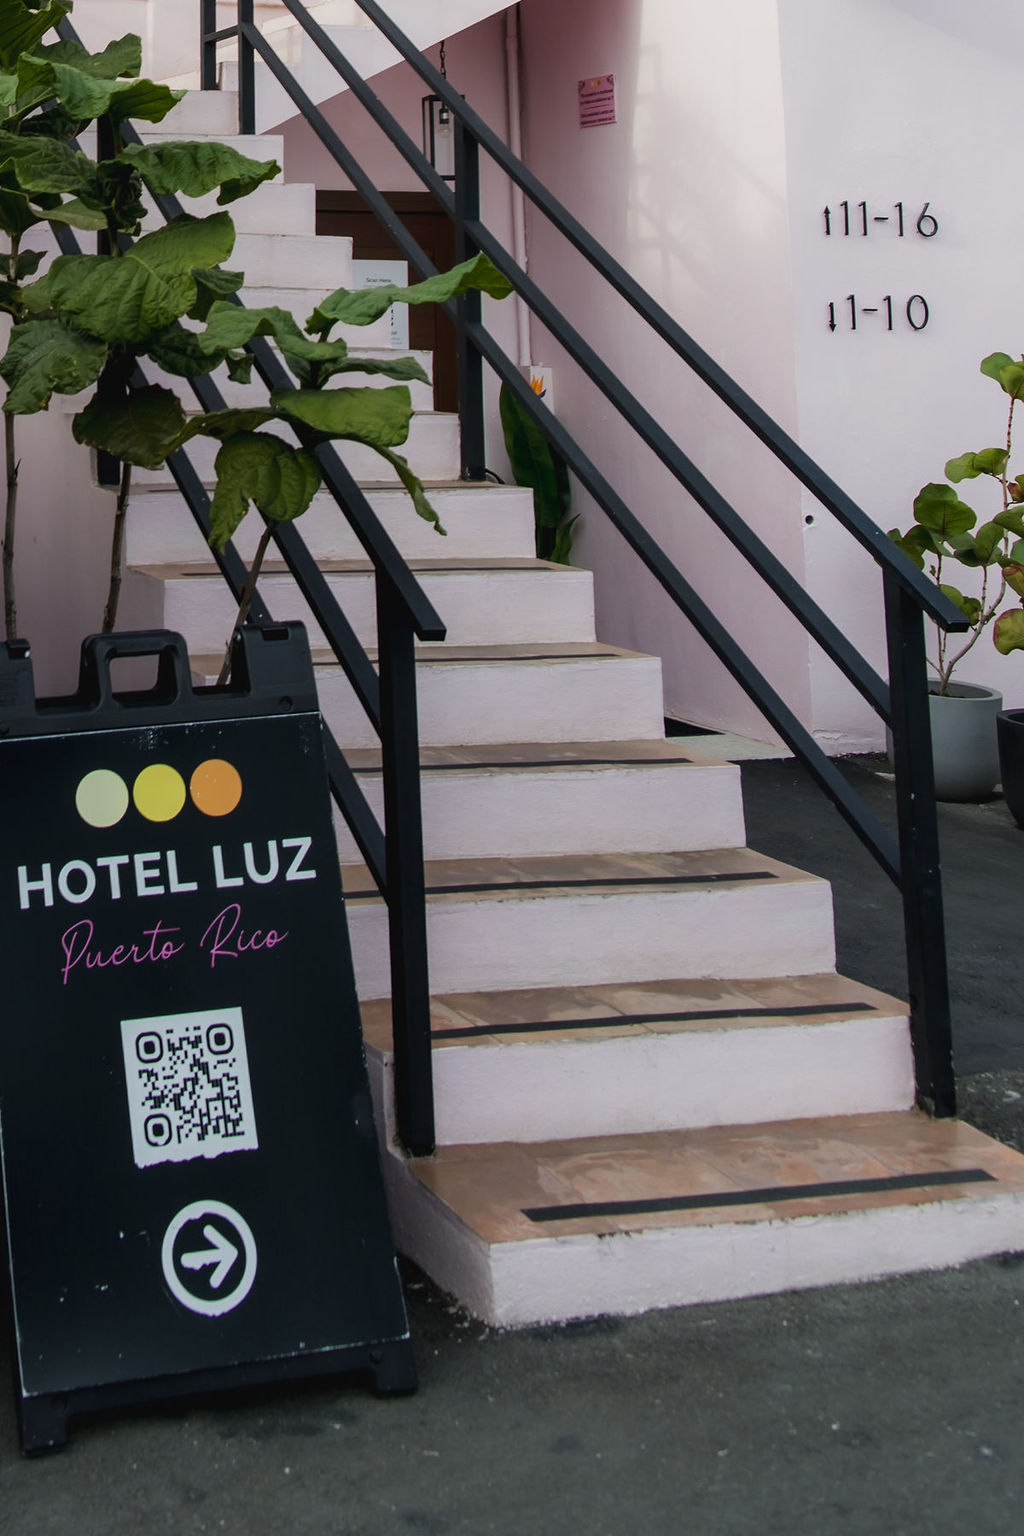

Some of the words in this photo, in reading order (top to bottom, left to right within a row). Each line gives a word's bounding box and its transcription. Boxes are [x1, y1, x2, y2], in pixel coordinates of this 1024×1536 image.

[839, 200, 939, 238] 11-16
[846, 294, 930, 331] 1-10
[17, 849, 198, 909] HOTEL
[212, 836, 317, 889] LUZ
[60, 919, 186, 985] Puerto
[199, 903, 290, 968] Rico
